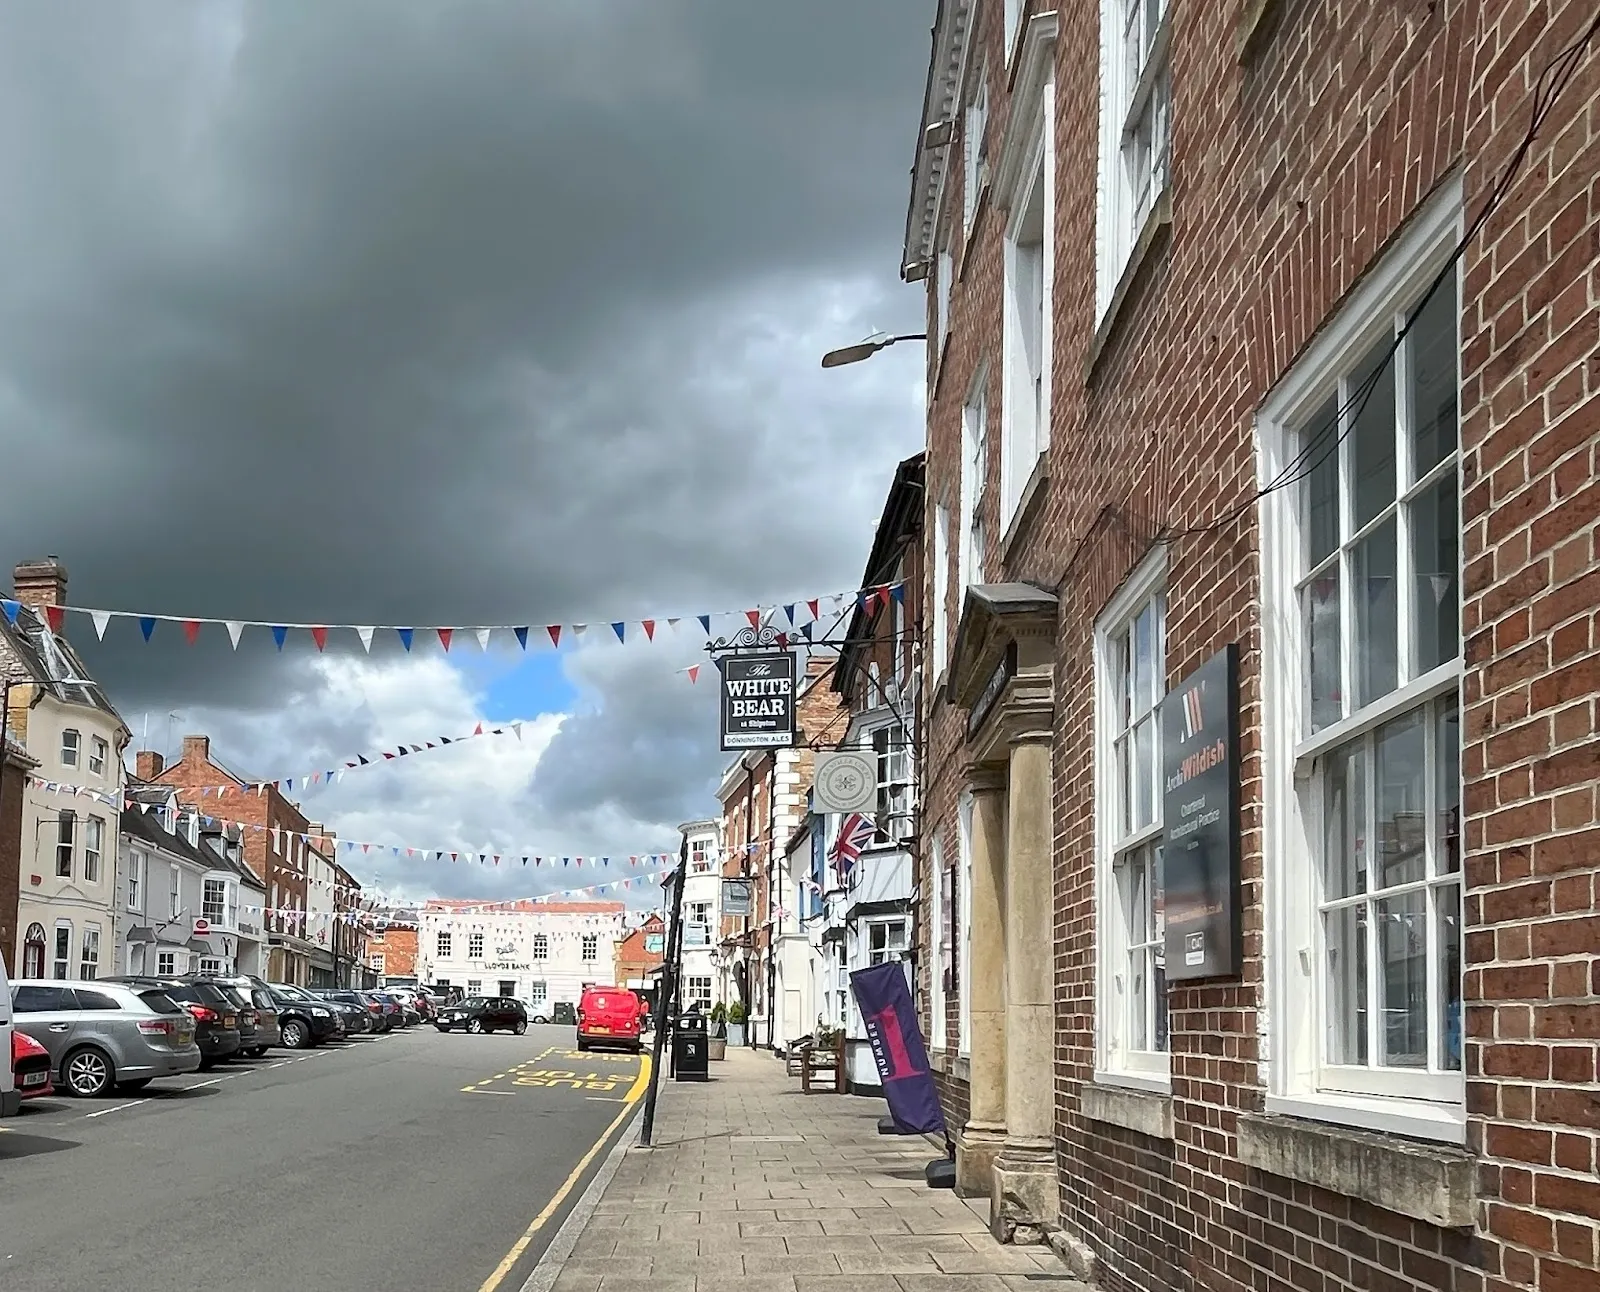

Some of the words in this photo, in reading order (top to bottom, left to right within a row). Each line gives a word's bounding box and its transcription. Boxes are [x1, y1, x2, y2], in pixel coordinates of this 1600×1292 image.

[746, 664, 771, 677] The
[726, 678, 792, 697] WHITE
[732, 699, 785, 717] BEAR
[726, 736, 769, 744] DONNINGTON
[770, 735, 790, 743] ALES
[868, 1022, 889, 1076] NUMBER
[516, 1070, 637, 1082] STOP
[512, 1077, 617, 1091] BUS
